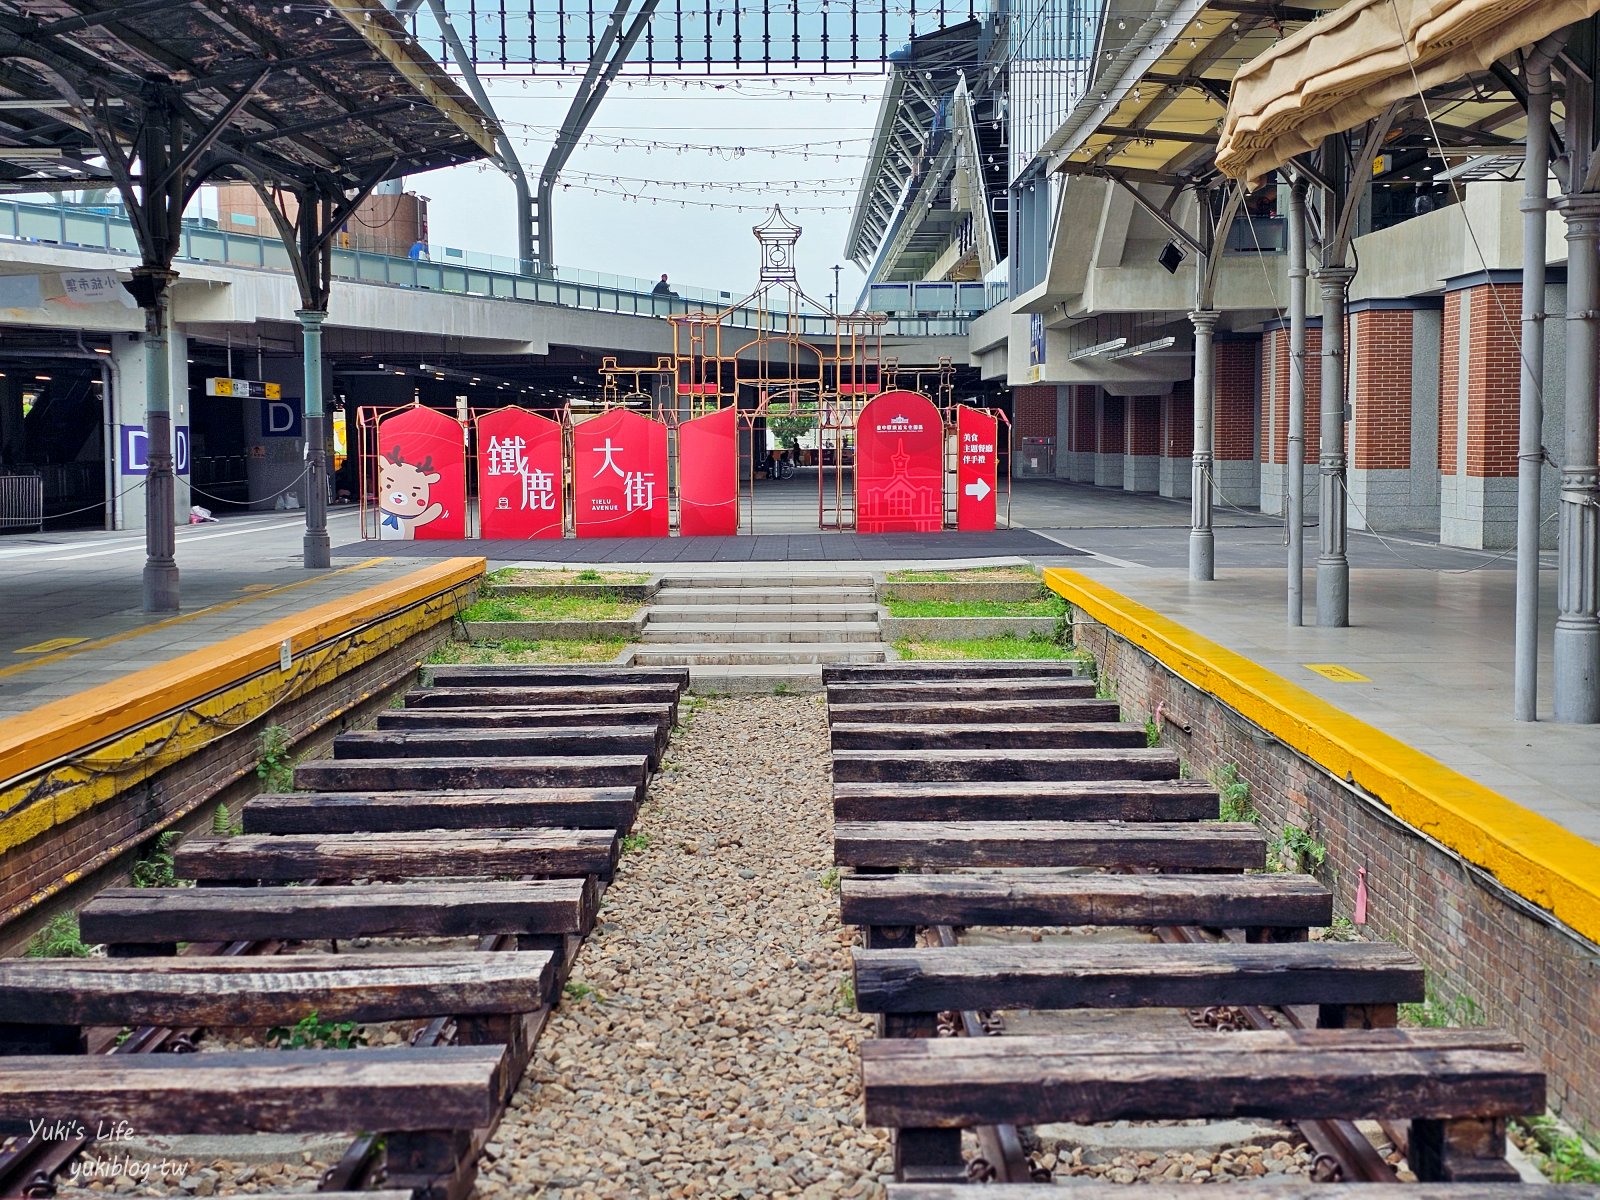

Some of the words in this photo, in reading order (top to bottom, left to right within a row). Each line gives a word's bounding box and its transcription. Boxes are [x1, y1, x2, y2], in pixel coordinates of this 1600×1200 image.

[268, 402, 295, 432] D
[177, 431, 187, 470] D
[963, 433, 978, 442] 美食
[963, 444, 994, 453] 主題餐廳
[486, 435, 556, 511] 鐵鹿
[963, 455, 986, 464] 伴手禮
[592, 438, 656, 512] 大街
